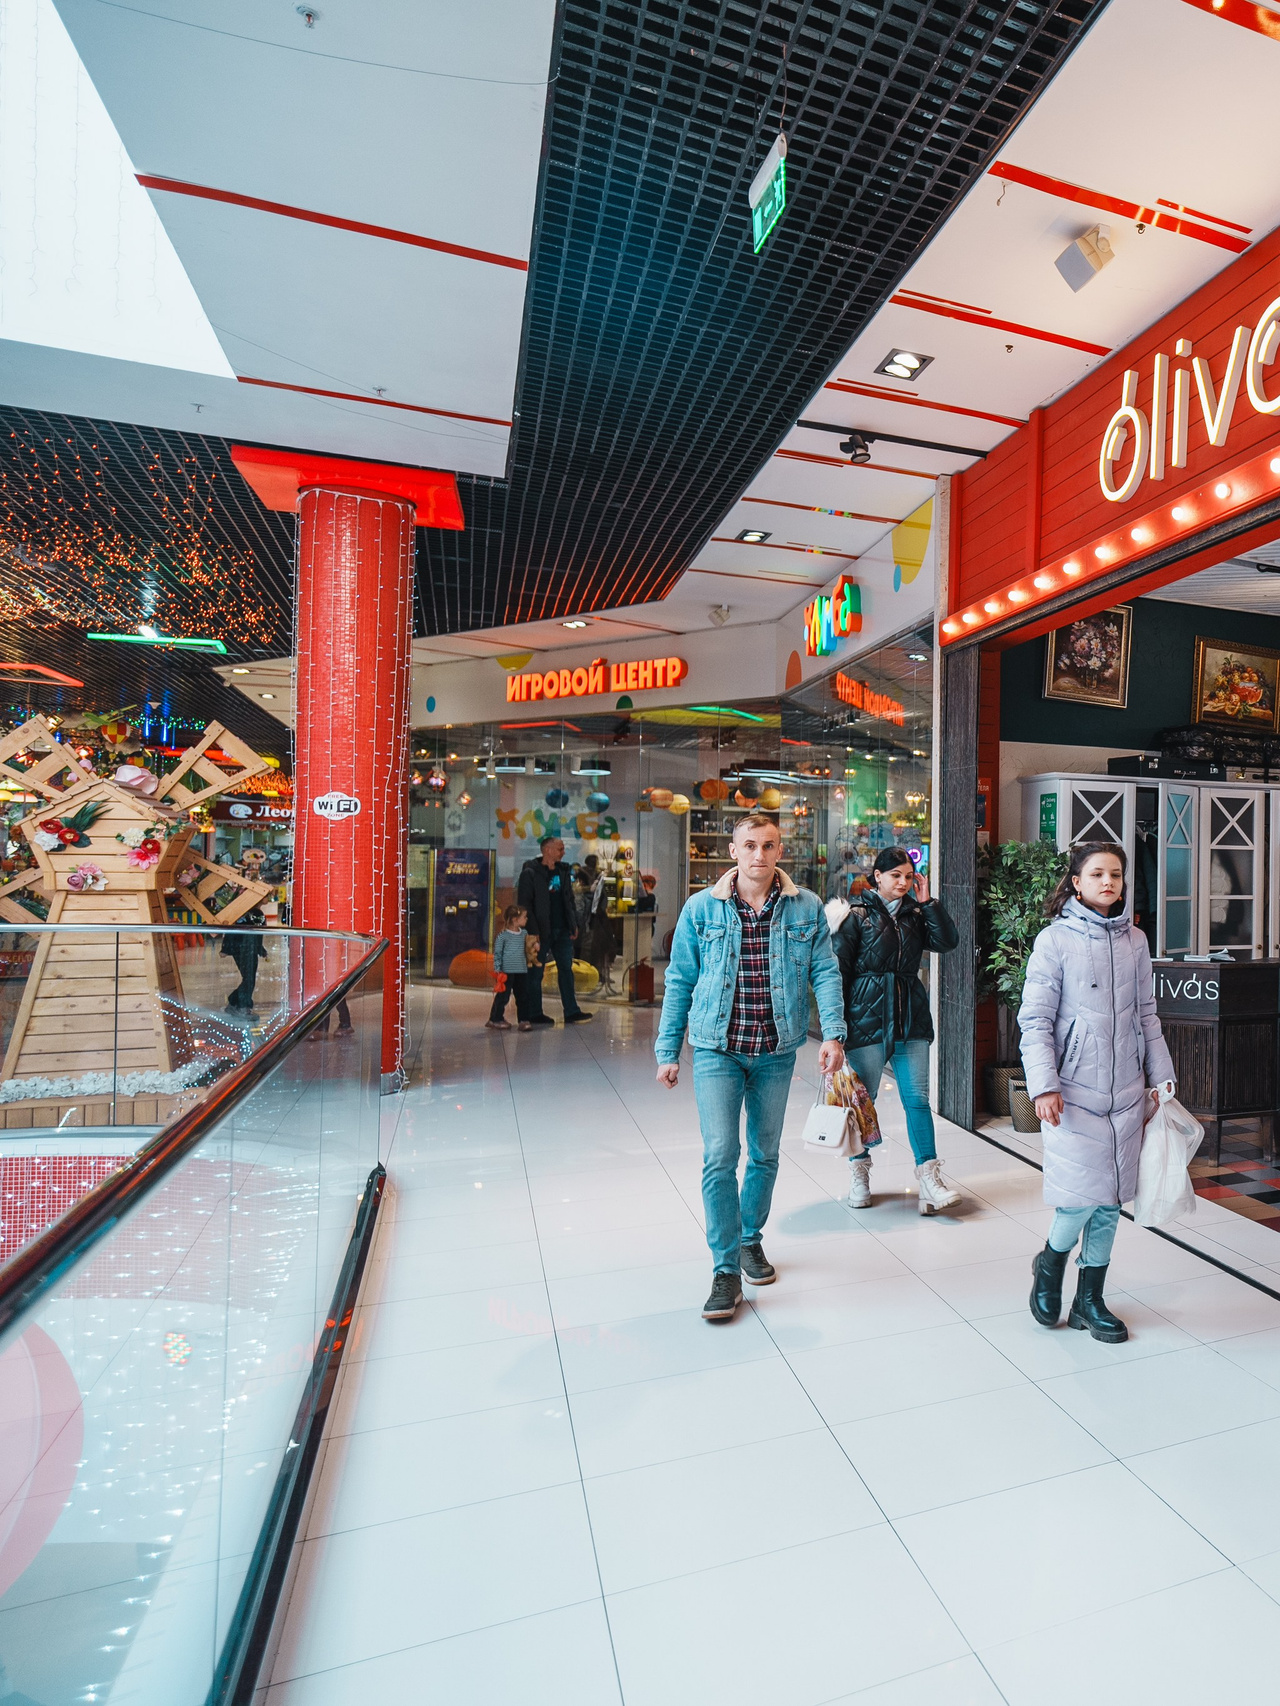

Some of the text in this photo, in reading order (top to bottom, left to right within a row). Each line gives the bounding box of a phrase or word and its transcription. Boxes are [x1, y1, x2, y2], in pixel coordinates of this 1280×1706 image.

[506, 656, 689, 703] ИГРОВОЙ ЦЕНТР
[1152, 972, 1219, 1000] livás
